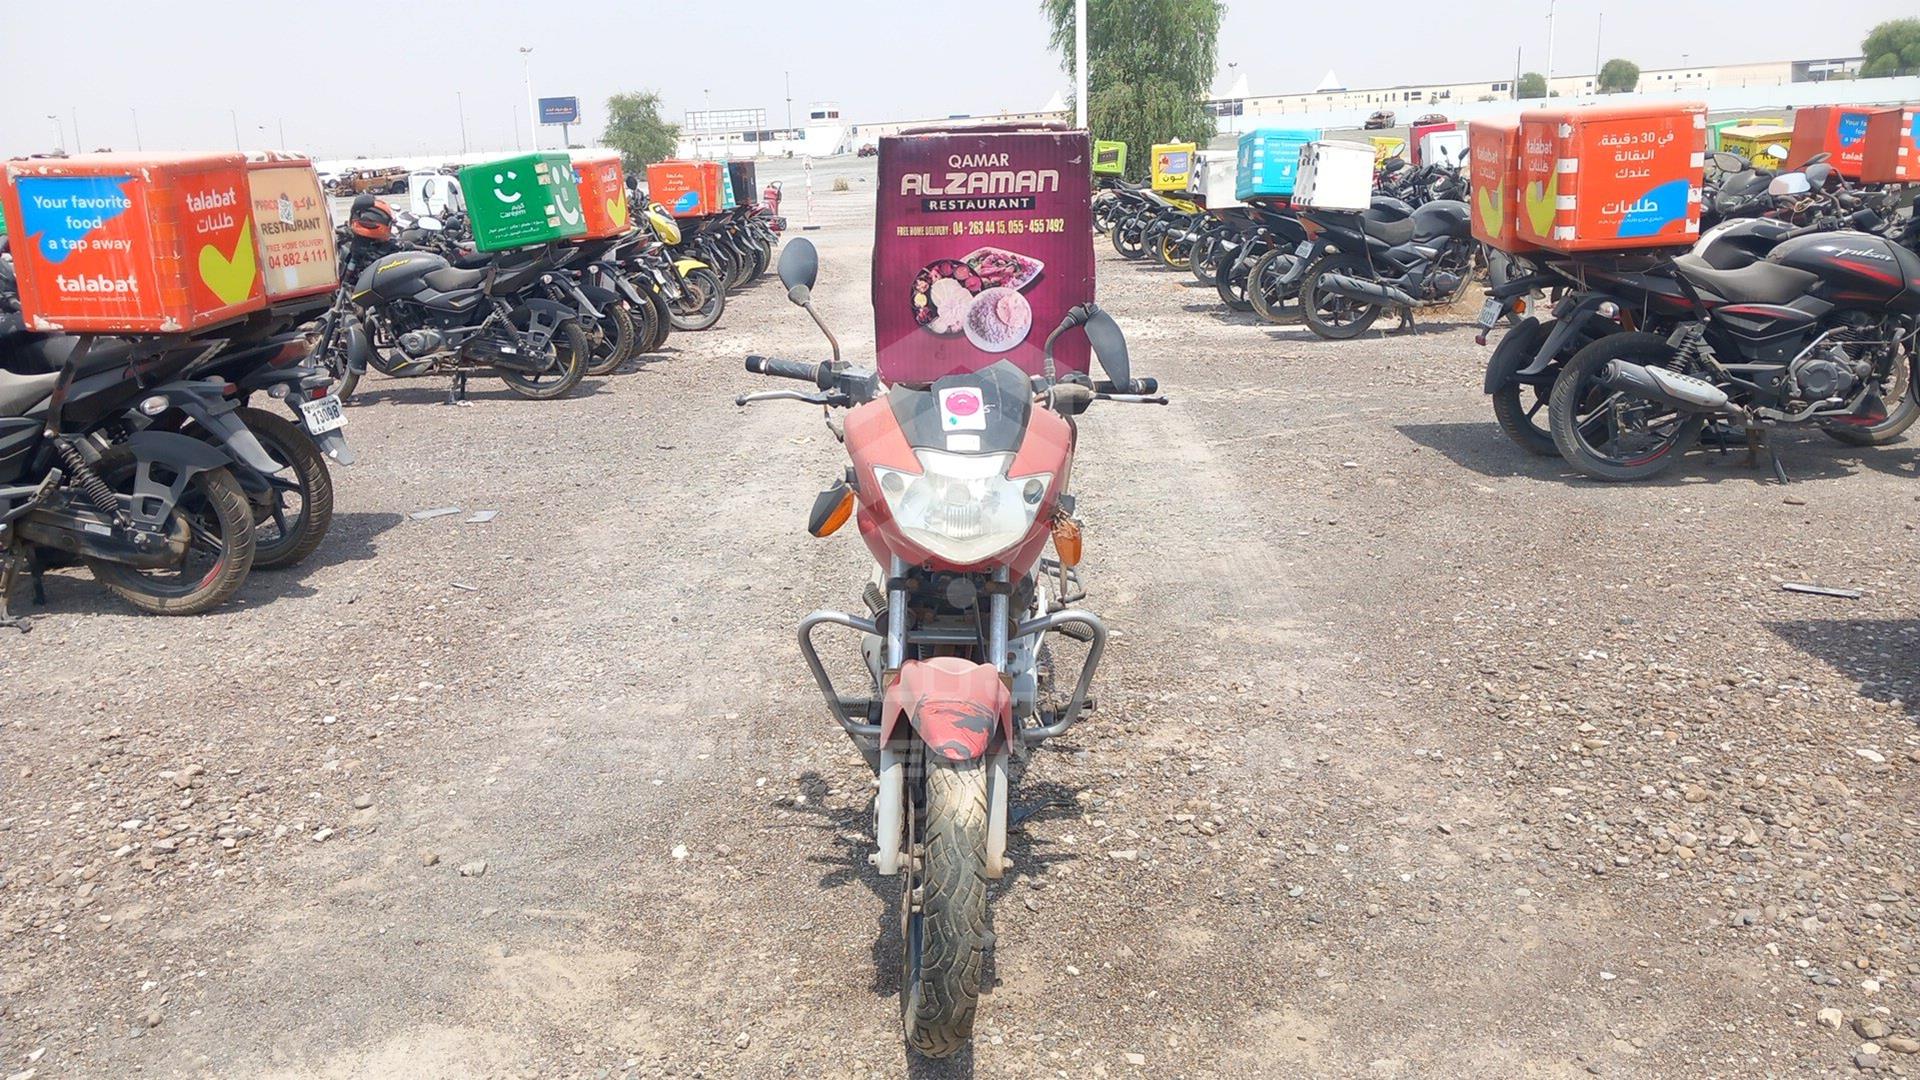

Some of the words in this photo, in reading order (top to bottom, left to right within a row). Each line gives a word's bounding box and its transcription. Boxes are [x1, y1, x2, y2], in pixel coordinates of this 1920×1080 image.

[1526, 137, 1553, 155] talabat
[1640, 132, 1655, 143] 30
[1657, 130, 1674, 148] في
[948, 153, 1010, 169] QAMAR
[1614, 148, 1655, 163] البقالة
[1615, 167, 1650, 179] عندك
[901, 169, 1060, 196] ALZAMAN
[33, 195, 68, 209] Your
[71, 194, 132, 209] favorite
[186, 186, 237, 213] talabat
[928, 198, 1030, 211] RESTAURANT
[1601, 198, 1659, 217] طلبات
[65, 215, 107, 232] food,
[196, 213, 235, 235] طلبات
[260, 217, 321, 236] RESTAURANT
[952, 221, 963, 236] 04
[968, 220, 984, 236] 263
[985, 220, 996, 235] 44
[1008, 219, 1024, 235] 055
[1029, 219, 1045, 234] 455
[1045, 218, 1065, 233] 7492
[48, 239, 58, 250] a
[60, 237, 88, 253] tap
[92, 239, 132, 254] away
[266, 243, 280, 253] FREE
[268, 254, 281, 270] 04
[282, 252, 301, 267] 882
[303, 250, 309, 263] 4
[312, 248, 328, 262] 111
[56, 274, 139, 293] talabat
[312, 404, 340, 425] 13098
